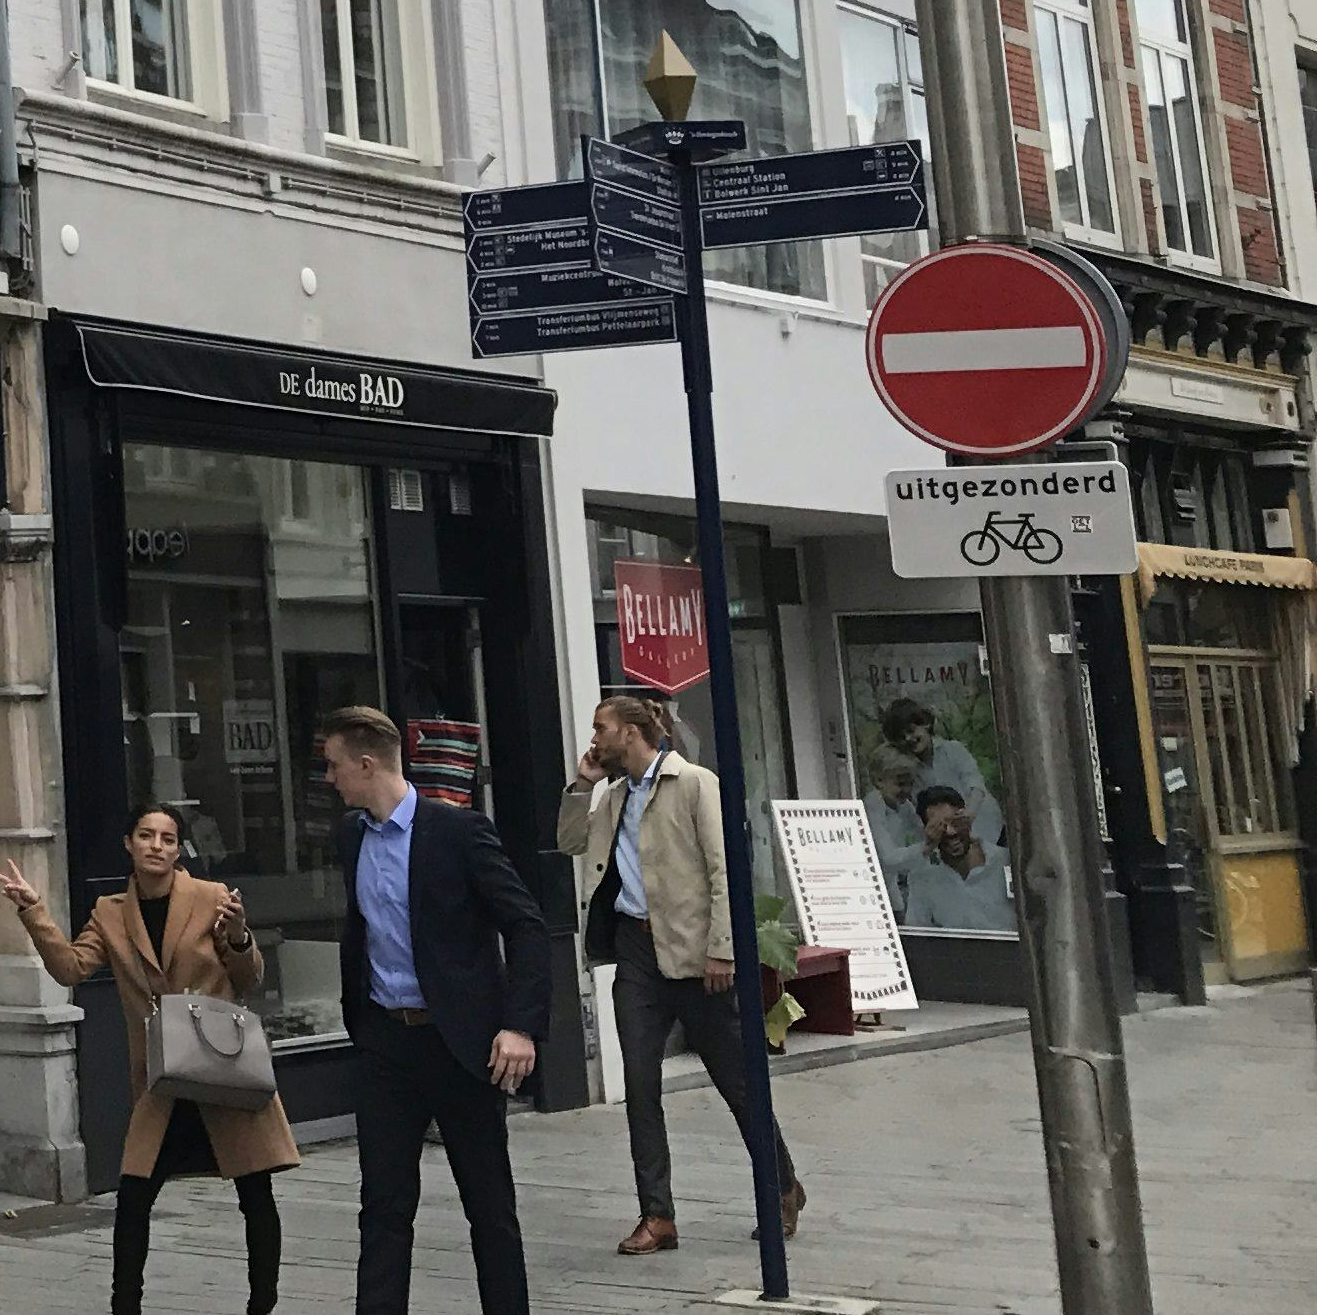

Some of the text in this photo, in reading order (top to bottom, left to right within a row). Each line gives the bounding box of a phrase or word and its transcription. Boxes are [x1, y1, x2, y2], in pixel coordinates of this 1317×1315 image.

[713, 172, 786, 187] Centraal Station
[714, 184, 789, 199] Bolwerk Sint Jan
[716, 207, 768, 220] Molenstraat
[507, 232, 543, 244] Stedelijk
[545, 229, 578, 240] Museum
[541, 241, 556, 251] Het
[537, 307, 659, 326] Transferiumbus Vlijmenseweg
[537, 318, 660, 337] Transferiumbus Pettelaarpark
[279, 366, 404, 407] DE dames BAD
[897, 470, 1116, 505] uitgezonderd
[623, 584, 702, 645] BELLAMY
[868, 661, 968, 693] BELLAMY
[229, 721, 272, 751] BAD
[797, 826, 854, 848] BELLAMY
